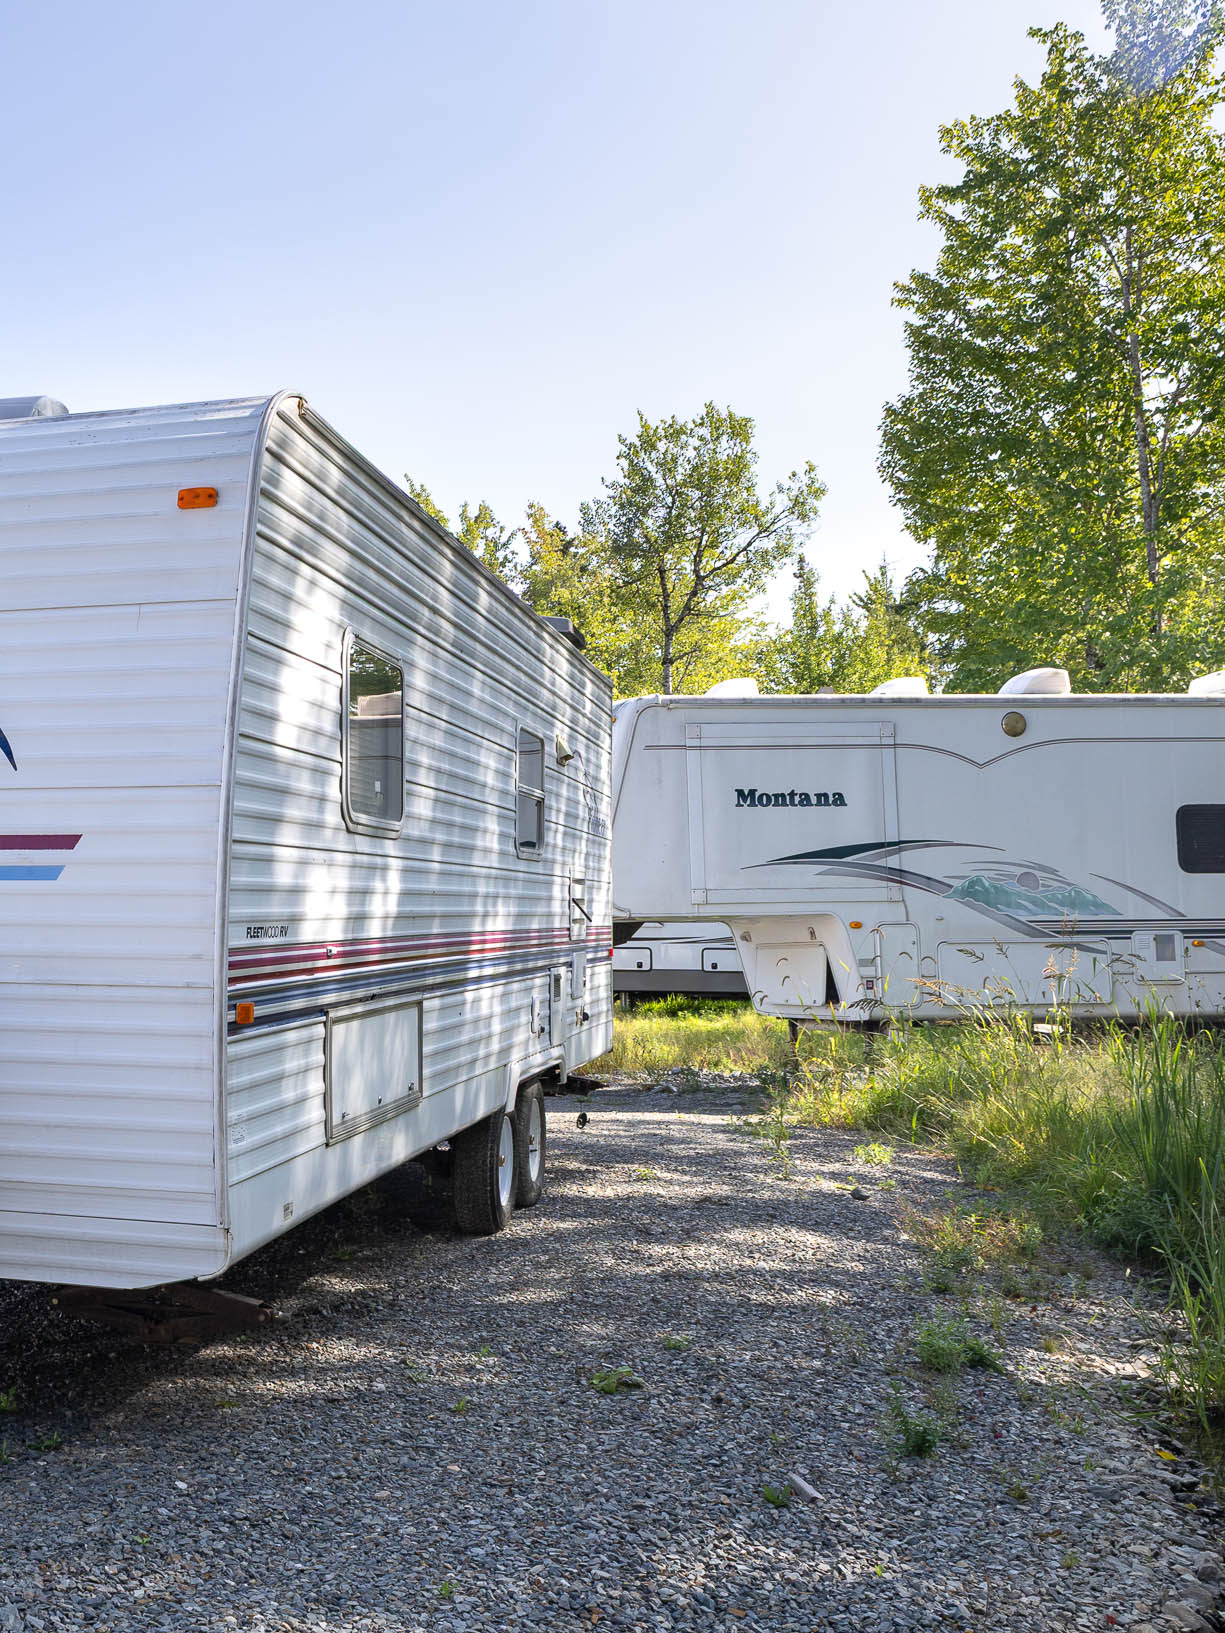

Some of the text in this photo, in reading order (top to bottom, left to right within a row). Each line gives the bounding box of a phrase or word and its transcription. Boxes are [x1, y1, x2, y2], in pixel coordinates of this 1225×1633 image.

[734, 788, 848, 808] Montana
[246, 925, 289, 939] FLEETWOOD RV
